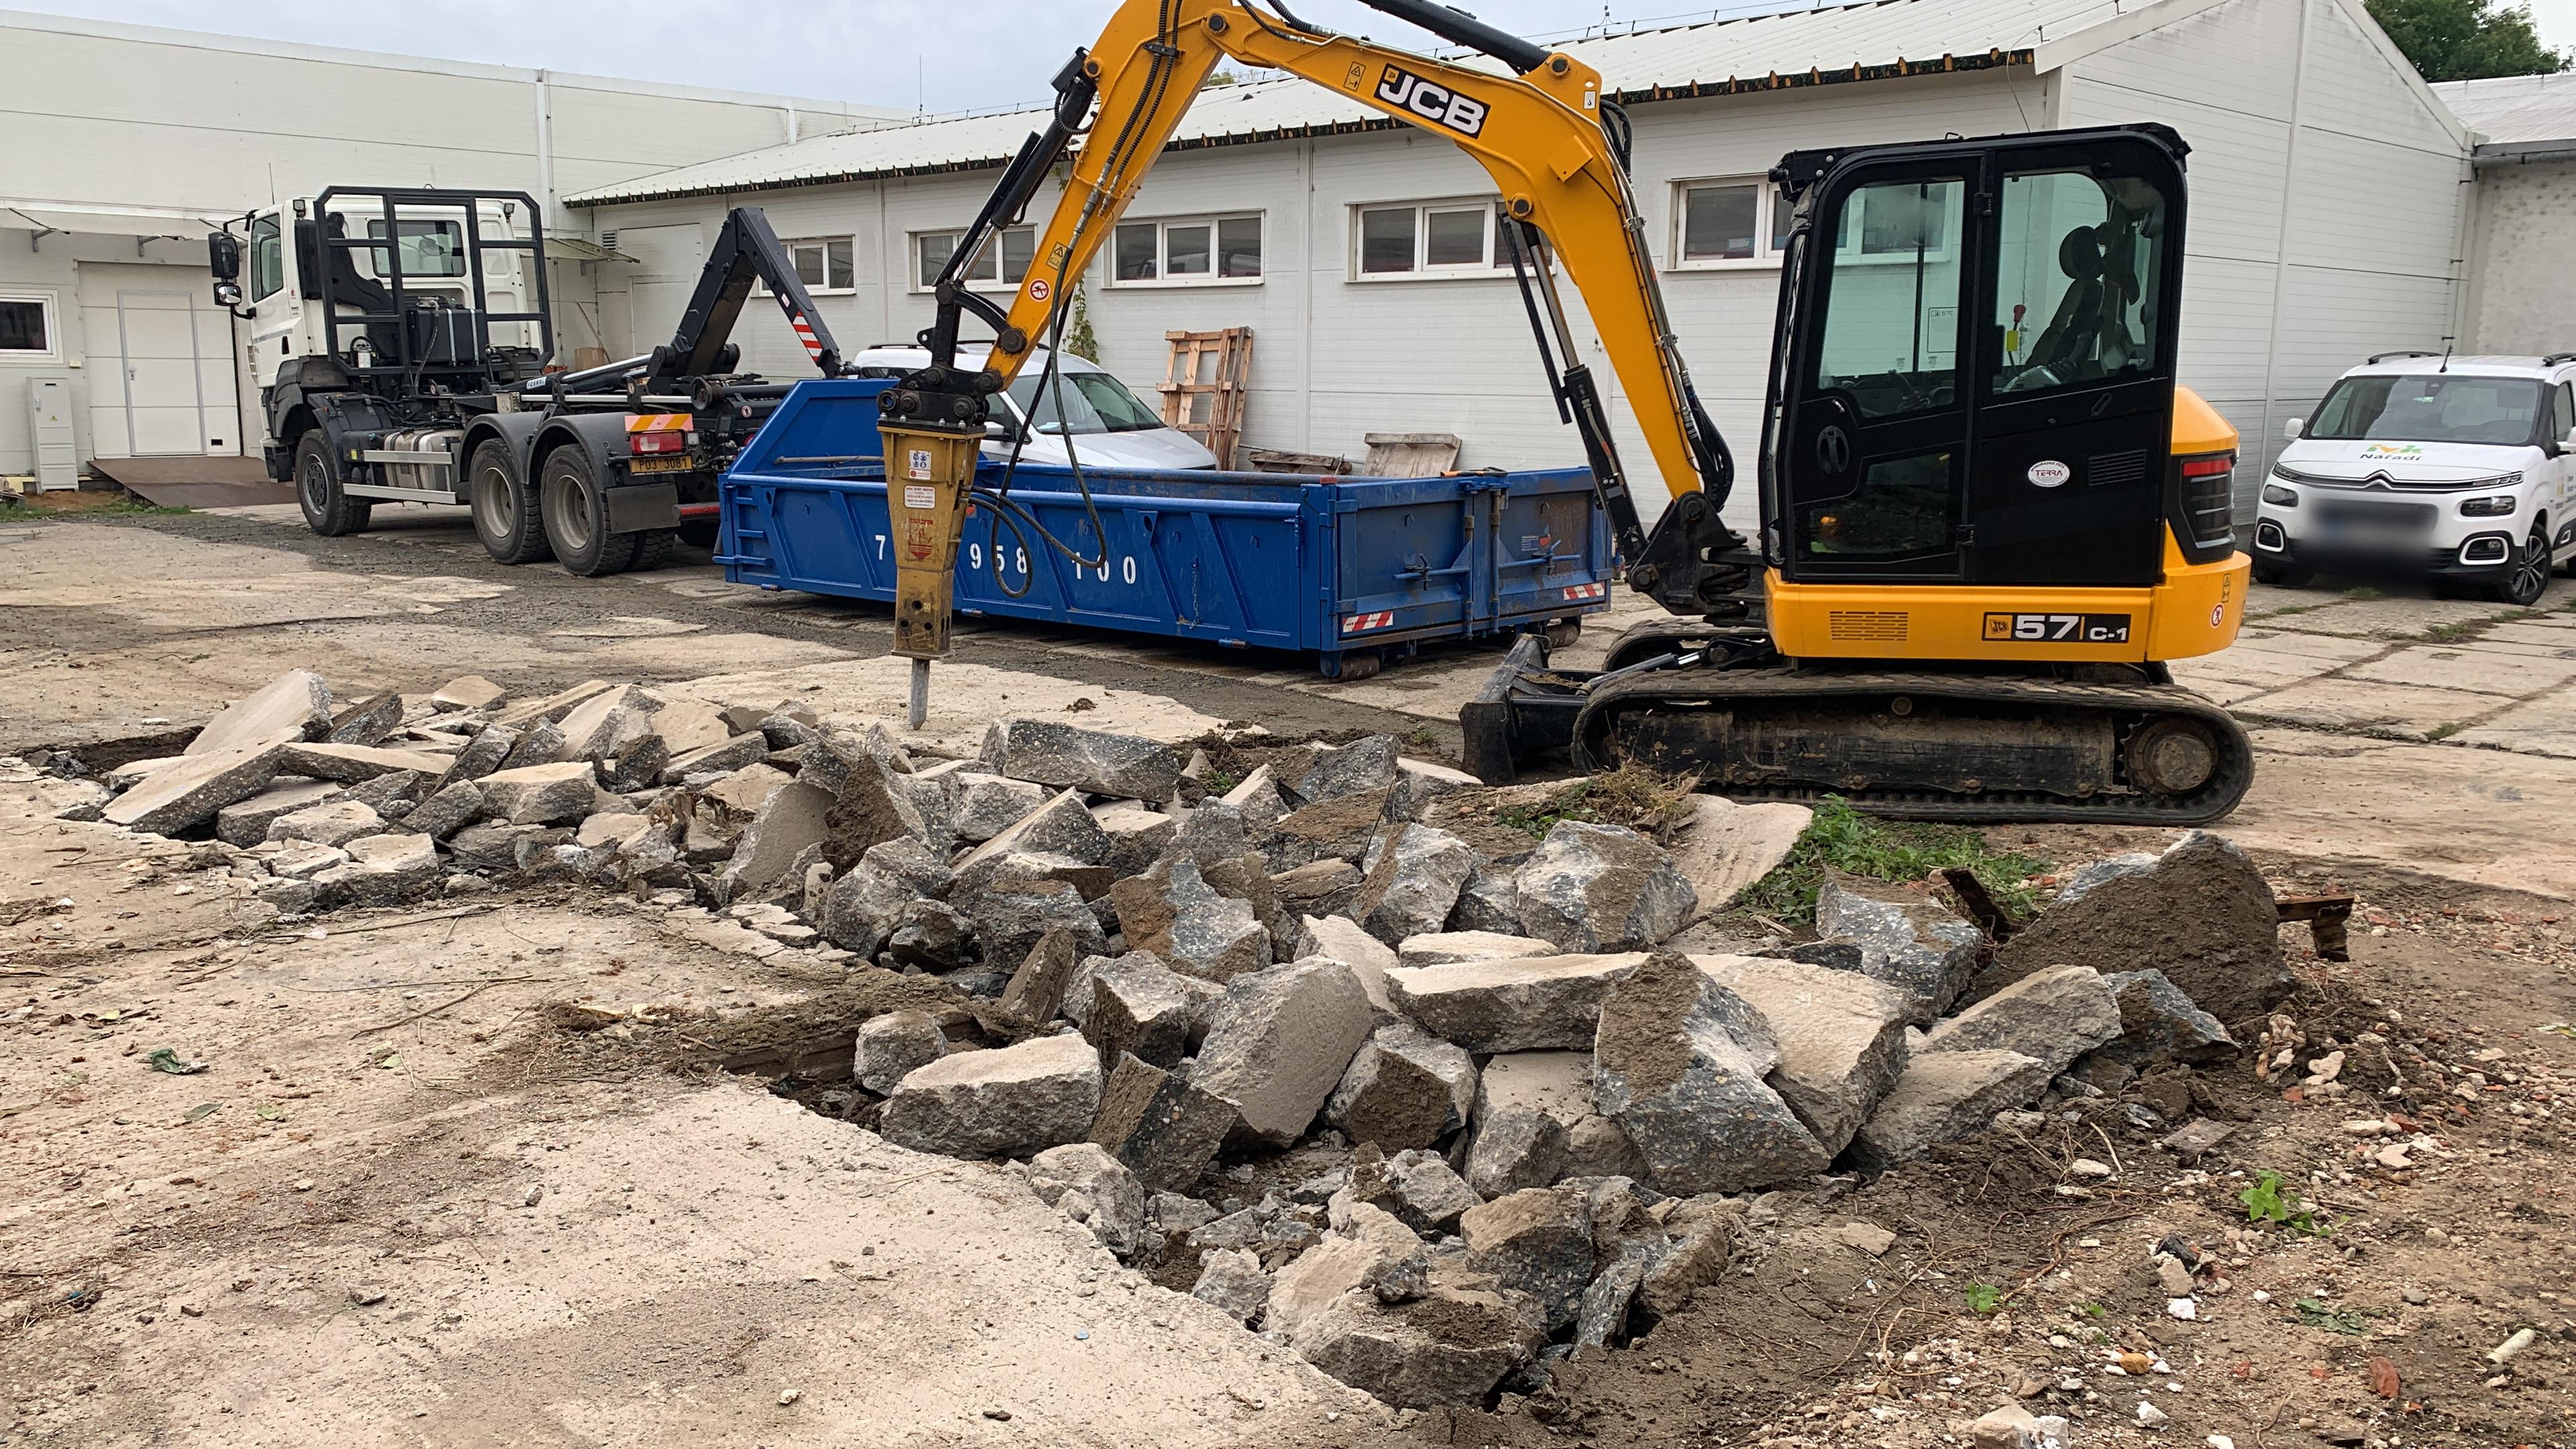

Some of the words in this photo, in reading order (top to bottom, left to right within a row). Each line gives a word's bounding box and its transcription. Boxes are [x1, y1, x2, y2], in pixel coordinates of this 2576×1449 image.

[1379, 74, 1484, 133] JCB
[639, 459, 657, 471] P03
[664, 457, 688, 470] 3081
[1990, 619, 2008, 634] JCB
[2015, 614, 2080, 639] 57
[2089, 627, 2128, 641] C-1
